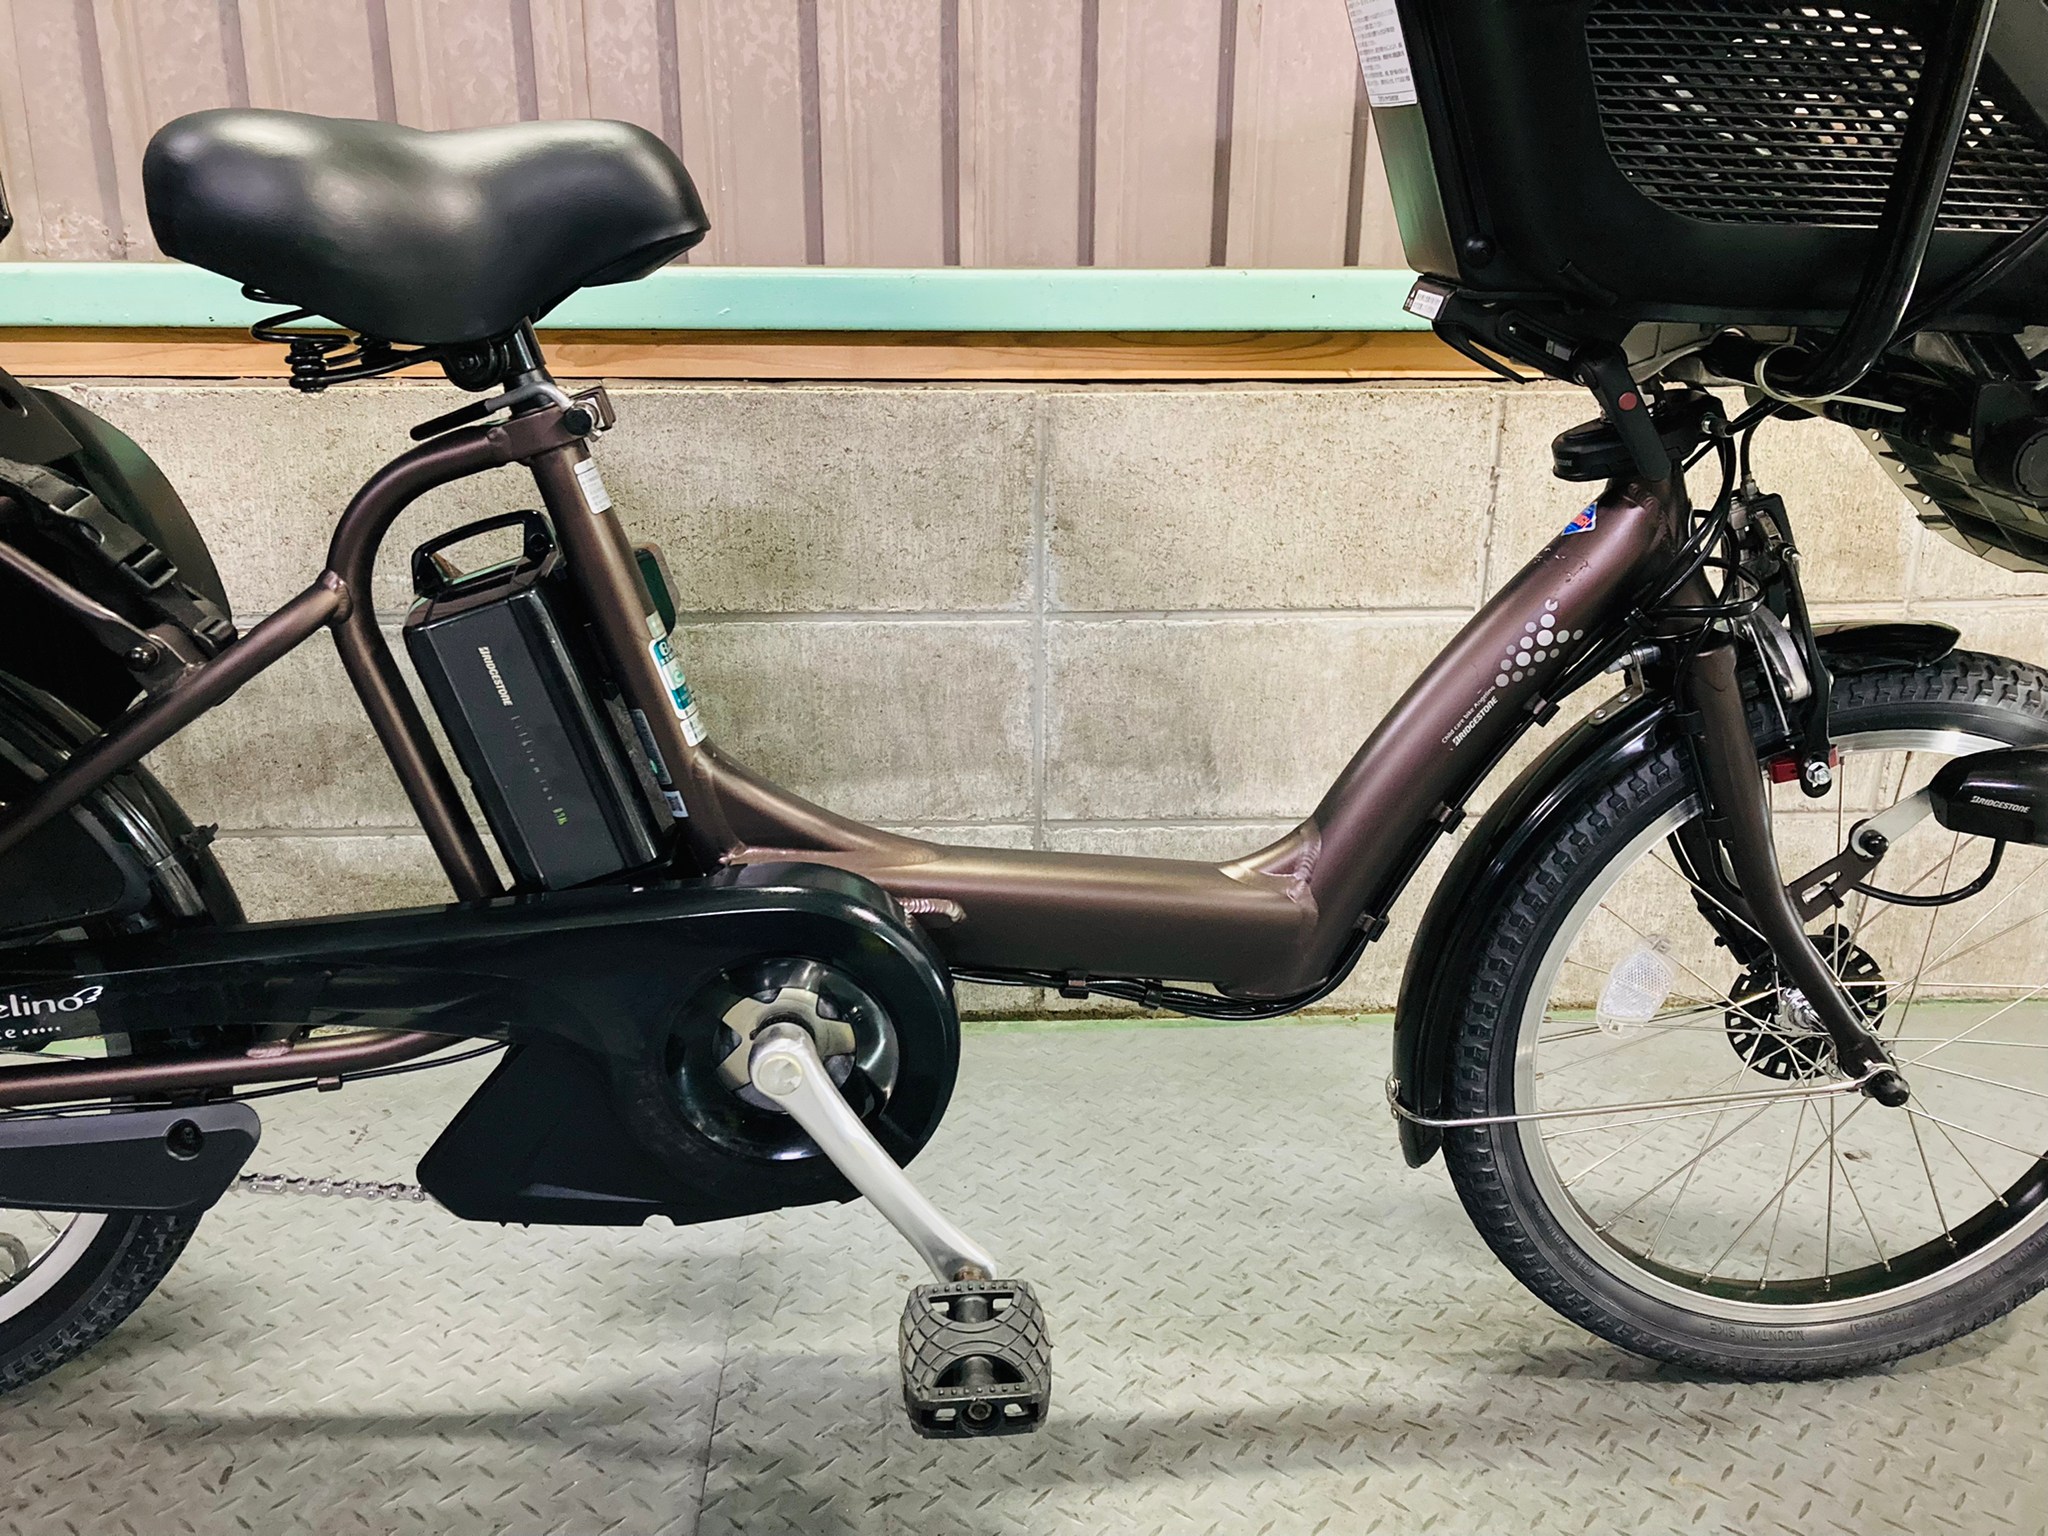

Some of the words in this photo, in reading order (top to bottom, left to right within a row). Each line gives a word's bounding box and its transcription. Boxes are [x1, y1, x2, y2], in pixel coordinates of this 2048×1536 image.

[478, 646, 513, 706] BRIDGESTONE
[1452, 695, 1499, 747] BRIDGESTONE
[1969, 795, 2031, 814] BRIDGESTONE
[1741, 1328, 1805, 1341] MOUNTAIN
